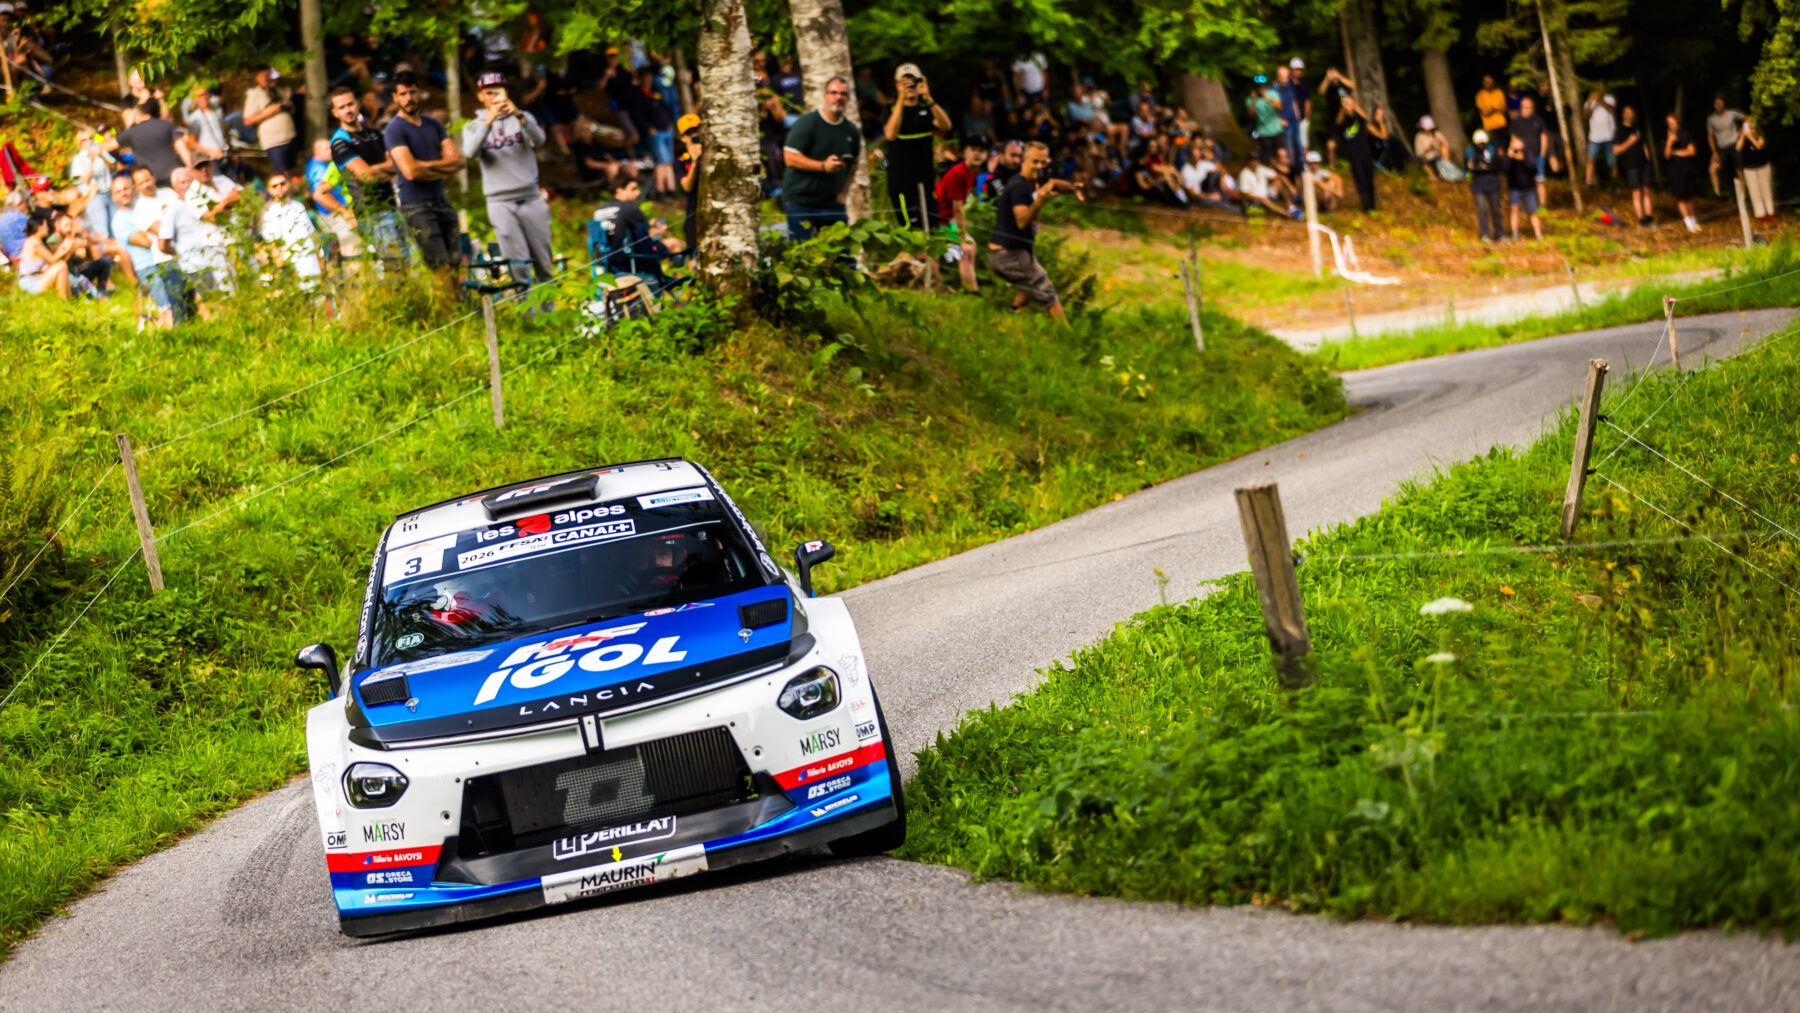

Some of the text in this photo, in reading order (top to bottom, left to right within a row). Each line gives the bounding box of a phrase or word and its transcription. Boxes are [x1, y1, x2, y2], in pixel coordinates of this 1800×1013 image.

[476, 504, 626, 543] les 2 alpes
[461, 550, 495, 564] 2026
[554, 522, 632, 543] CANAL+
[404, 556, 422, 576] 3
[397, 635, 421, 648] FIA
[473, 635, 688, 706] IGOL
[519, 681, 654, 716] LANCIA
[799, 727, 840, 757] MARSY
[856, 723, 876, 738] OMP
[362, 822, 405, 843] MARSY
[580, 861, 656, 890] MAURIN
